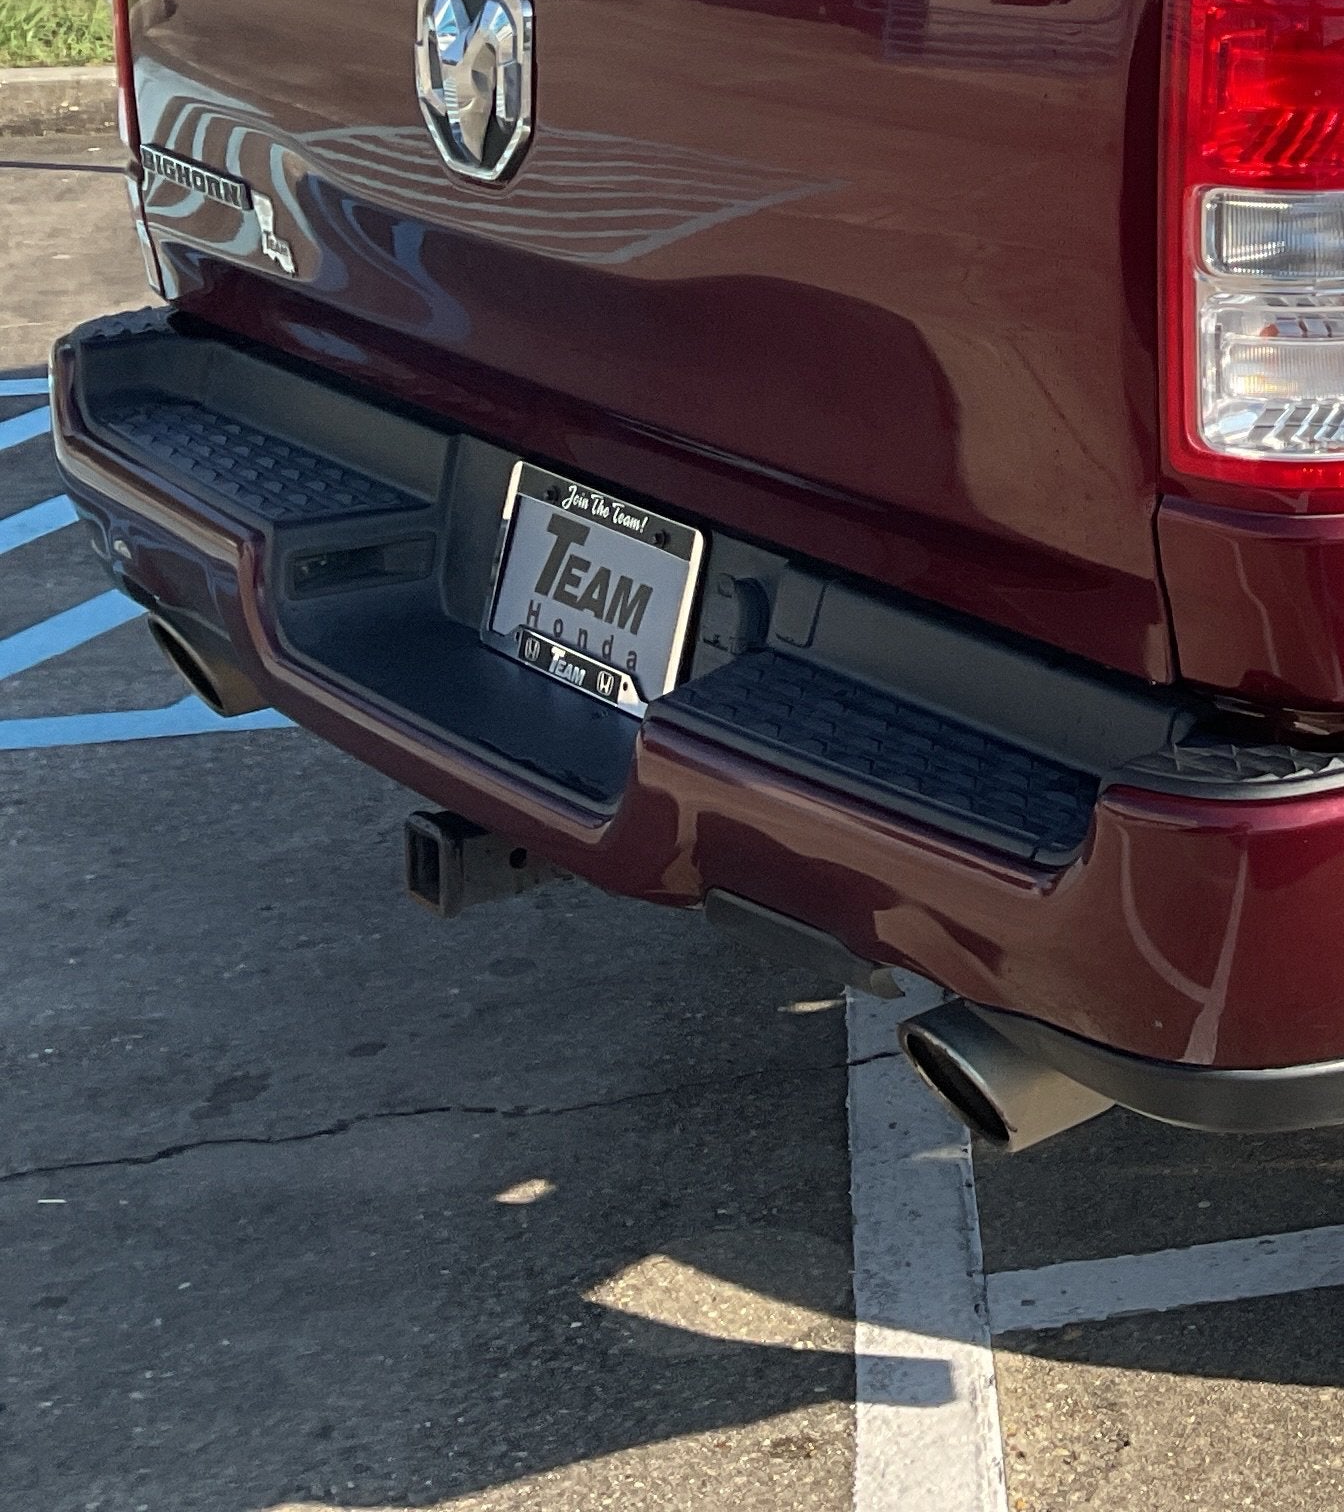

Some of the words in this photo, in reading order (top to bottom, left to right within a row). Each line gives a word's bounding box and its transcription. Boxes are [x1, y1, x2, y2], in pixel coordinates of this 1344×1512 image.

[141, 146, 243, 210] BIGHORN
[561, 485, 589, 510] Join
[590, 493, 610, 519] The
[612, 502, 650, 534] Team!
[534, 512, 654, 636] TEAM
[526, 599, 638, 672] Honda
[548, 645, 587, 687] TEAM
